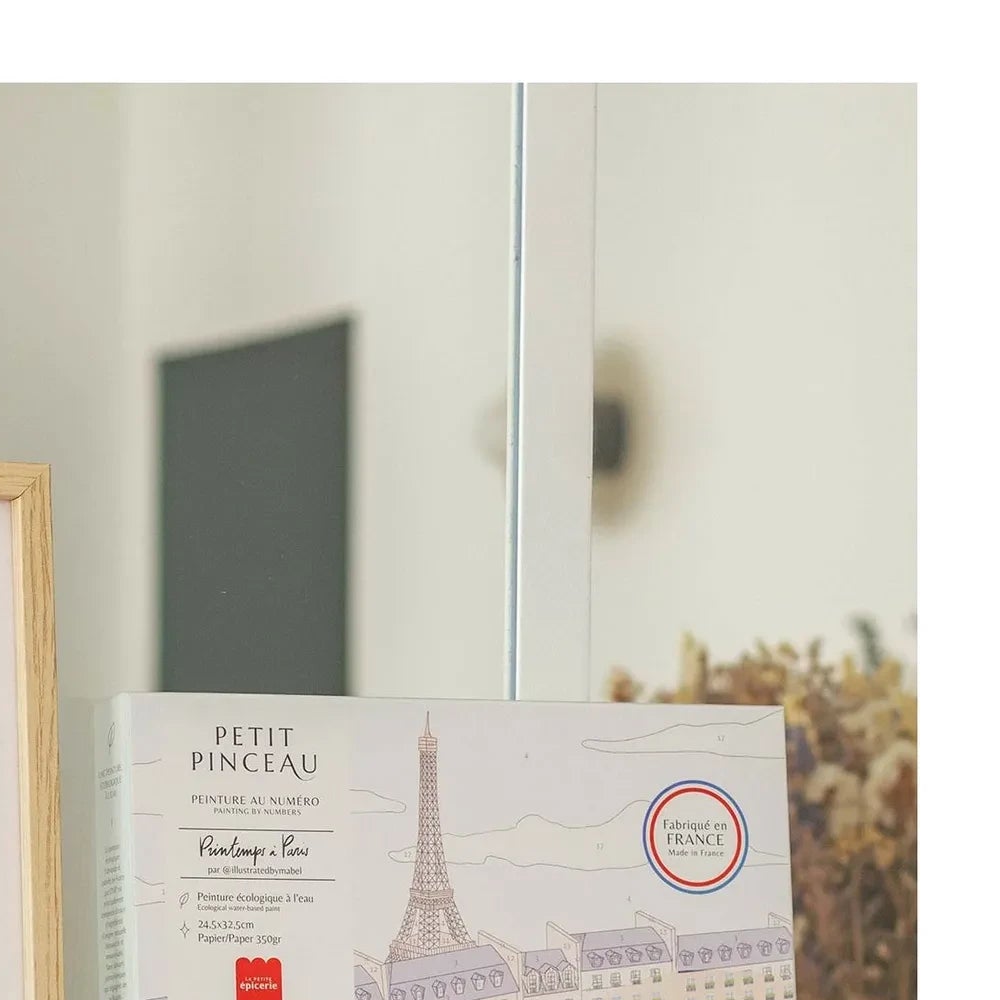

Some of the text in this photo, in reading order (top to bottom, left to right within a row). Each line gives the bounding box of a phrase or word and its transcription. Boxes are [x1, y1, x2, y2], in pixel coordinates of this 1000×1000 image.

[216, 726, 294, 746] PETIT
[192, 752, 317, 781] PINCEAU
[191, 794, 320, 806] PEINTURE AU NUMÉRO
[664, 820, 710, 832] Fabriqué
[668, 833, 724, 846] FRANCE
[200, 834, 265, 866] Printemps
[282, 834, 308, 858] Paris
[208, 866, 302, 876] par @illustratedbymabel
[198, 892, 234, 902] Peinture
[236, 893, 283, 905] écologique
[286, 894, 291, 902] à
[198, 934, 282, 945] Papier/Paper 350gr
[240, 981, 278, 991] épicerie
